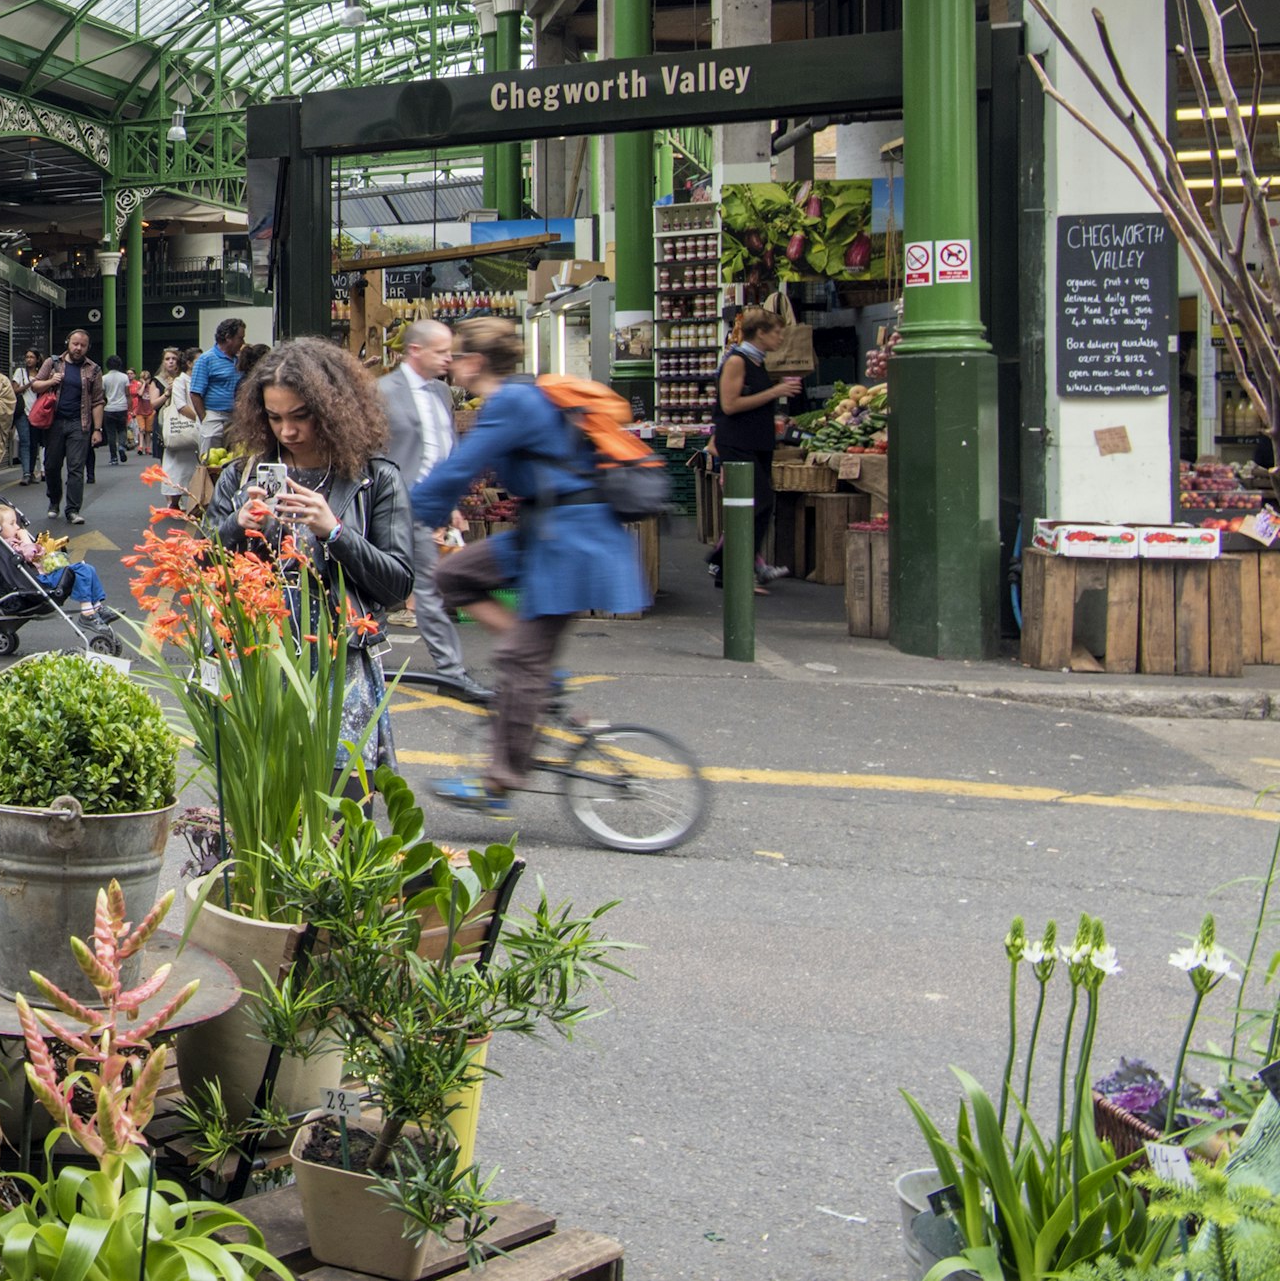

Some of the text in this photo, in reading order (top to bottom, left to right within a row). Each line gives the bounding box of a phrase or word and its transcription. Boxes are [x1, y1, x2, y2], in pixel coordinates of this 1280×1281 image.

[490, 61, 751, 111] Chegworth Valley
[1067, 224, 1164, 249] CHEGWORTH
[1091, 249, 1145, 270] VALLEY
[1066, 278, 1097, 292] organic
[1103, 277, 1121, 289] fruit
[1134, 277, 1149, 289] veg
[1064, 292, 1151, 307] delivered daily from
[1109, 306, 1129, 317] farm
[1093, 316, 1117, 325] miles
[1066, 337, 1085, 350] Box
[1087, 339, 1119, 355] delivery
[1068, 370, 1089, 380] open
